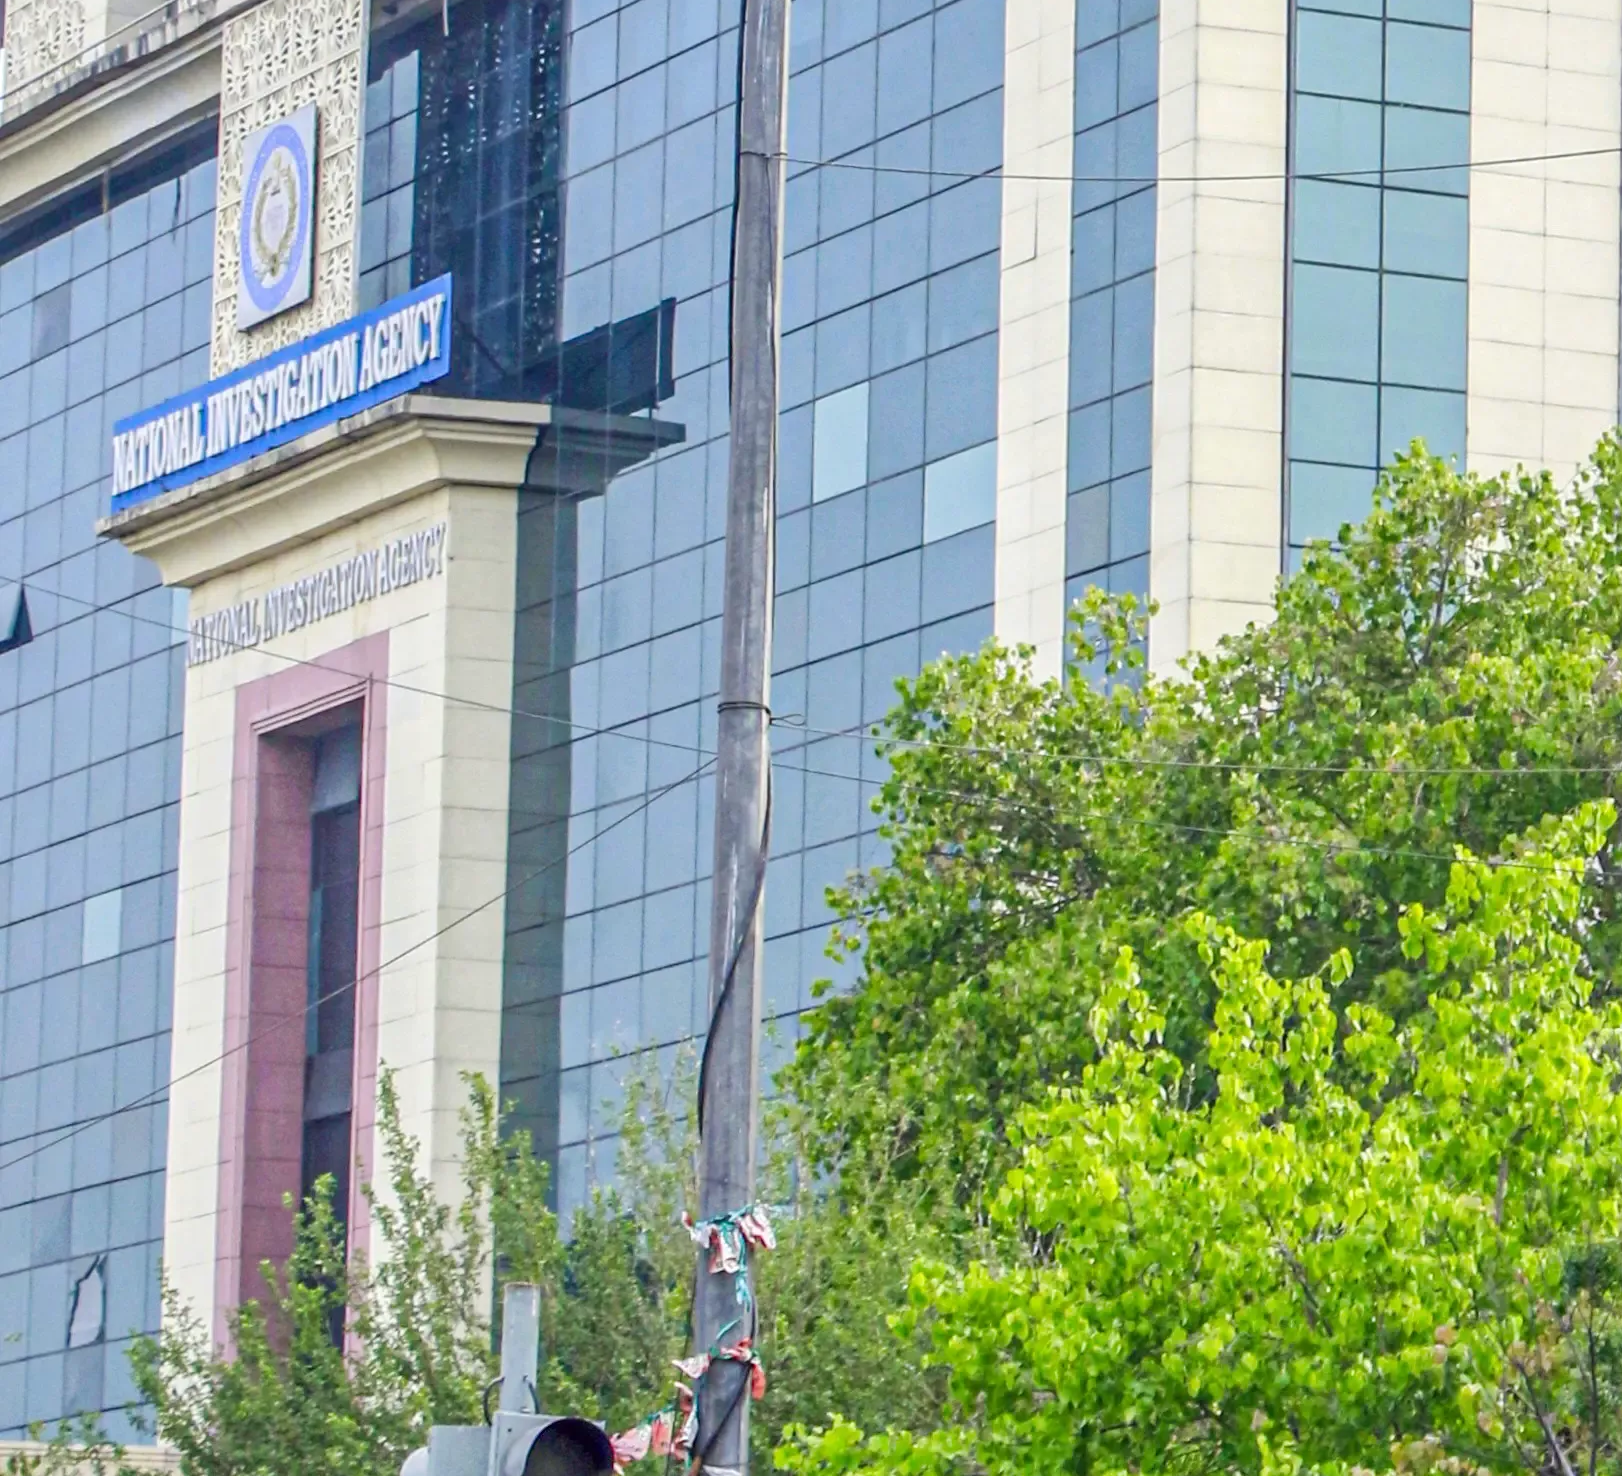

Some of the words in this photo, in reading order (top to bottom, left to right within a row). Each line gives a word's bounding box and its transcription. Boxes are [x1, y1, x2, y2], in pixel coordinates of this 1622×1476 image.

[111, 402, 206, 496] NATIONAL
[206, 331, 360, 458] INVESTIGATION
[358, 293, 447, 392] AGENCY
[263, 549, 379, 642] INVESTIGATION
[380, 522, 446, 596] AGENCY
